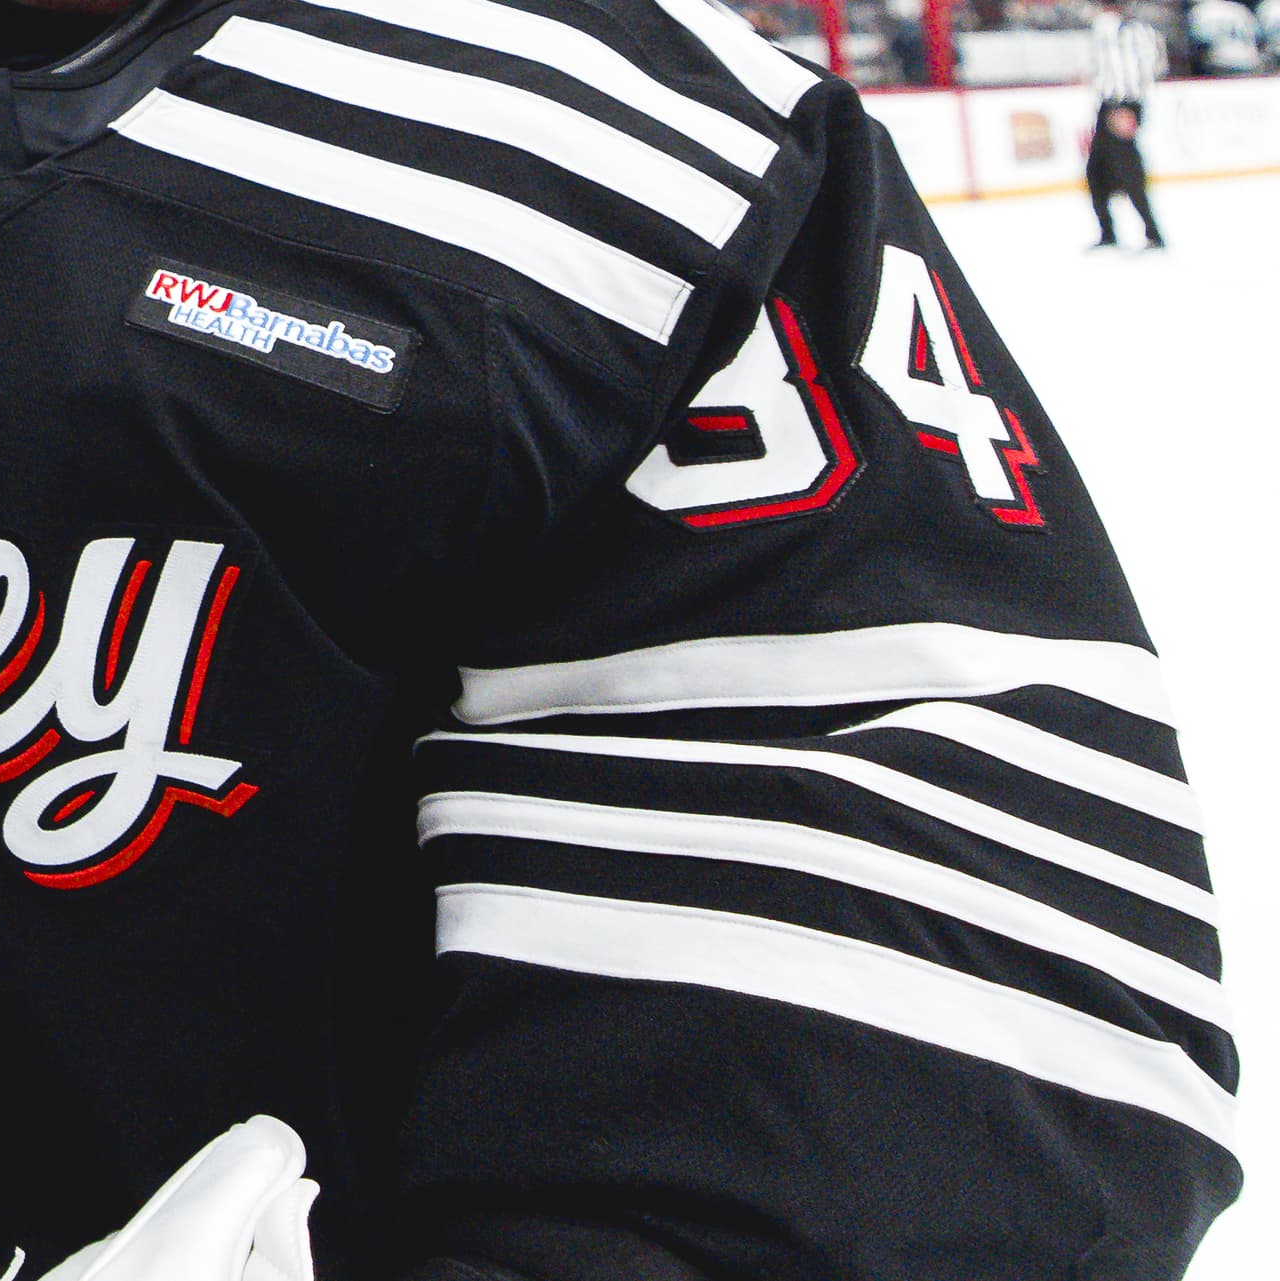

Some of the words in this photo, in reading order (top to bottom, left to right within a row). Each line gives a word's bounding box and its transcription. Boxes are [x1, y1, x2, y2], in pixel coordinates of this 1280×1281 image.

[150, 271, 395, 372] RWJBarnabas
[172, 304, 274, 350] HEALTH
[625, 244, 1044, 528] 34
